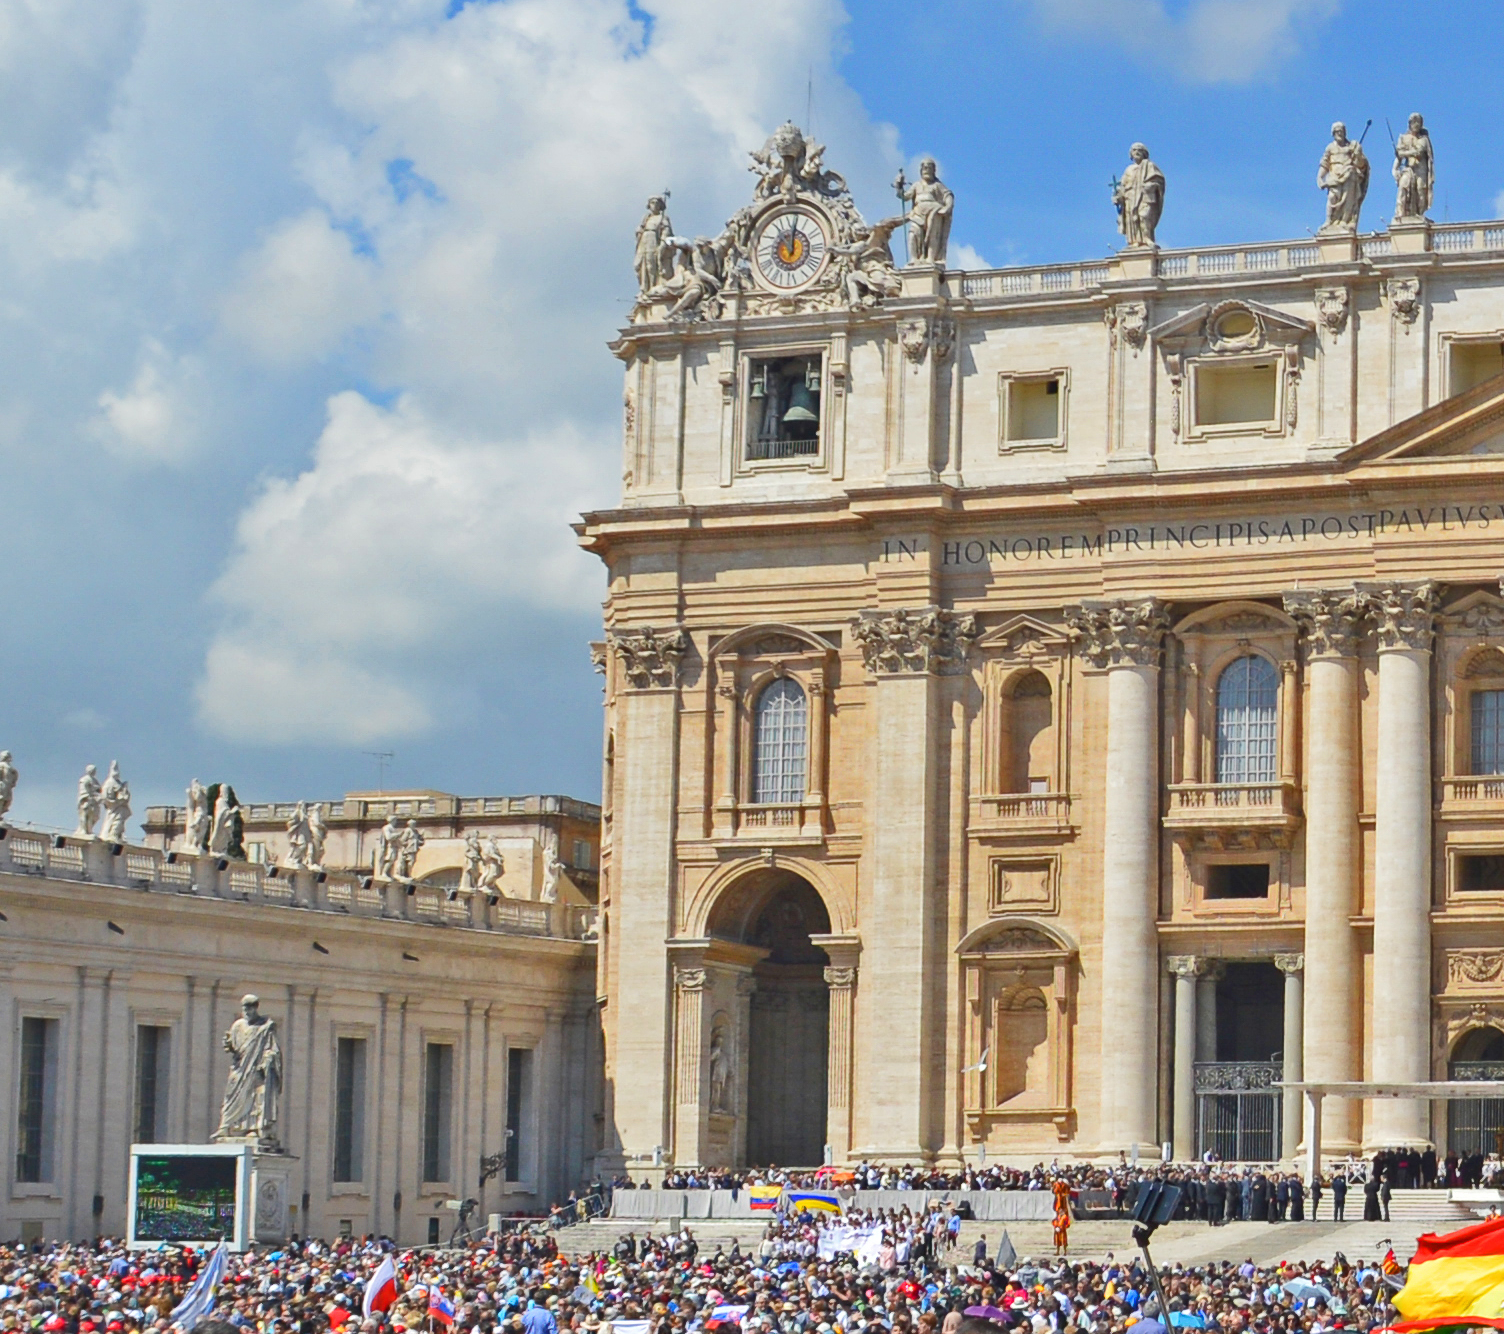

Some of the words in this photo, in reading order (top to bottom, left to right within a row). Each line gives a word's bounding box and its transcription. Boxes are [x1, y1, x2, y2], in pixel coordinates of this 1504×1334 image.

[883, 539, 917, 564] IN
[942, 534, 1104, 566] HONOREM
[1108, 520, 1270, 553] PRINCIPIS
[1277, 514, 1376, 544] APOST
[1379, 505, 1491, 534] PAVLVS
